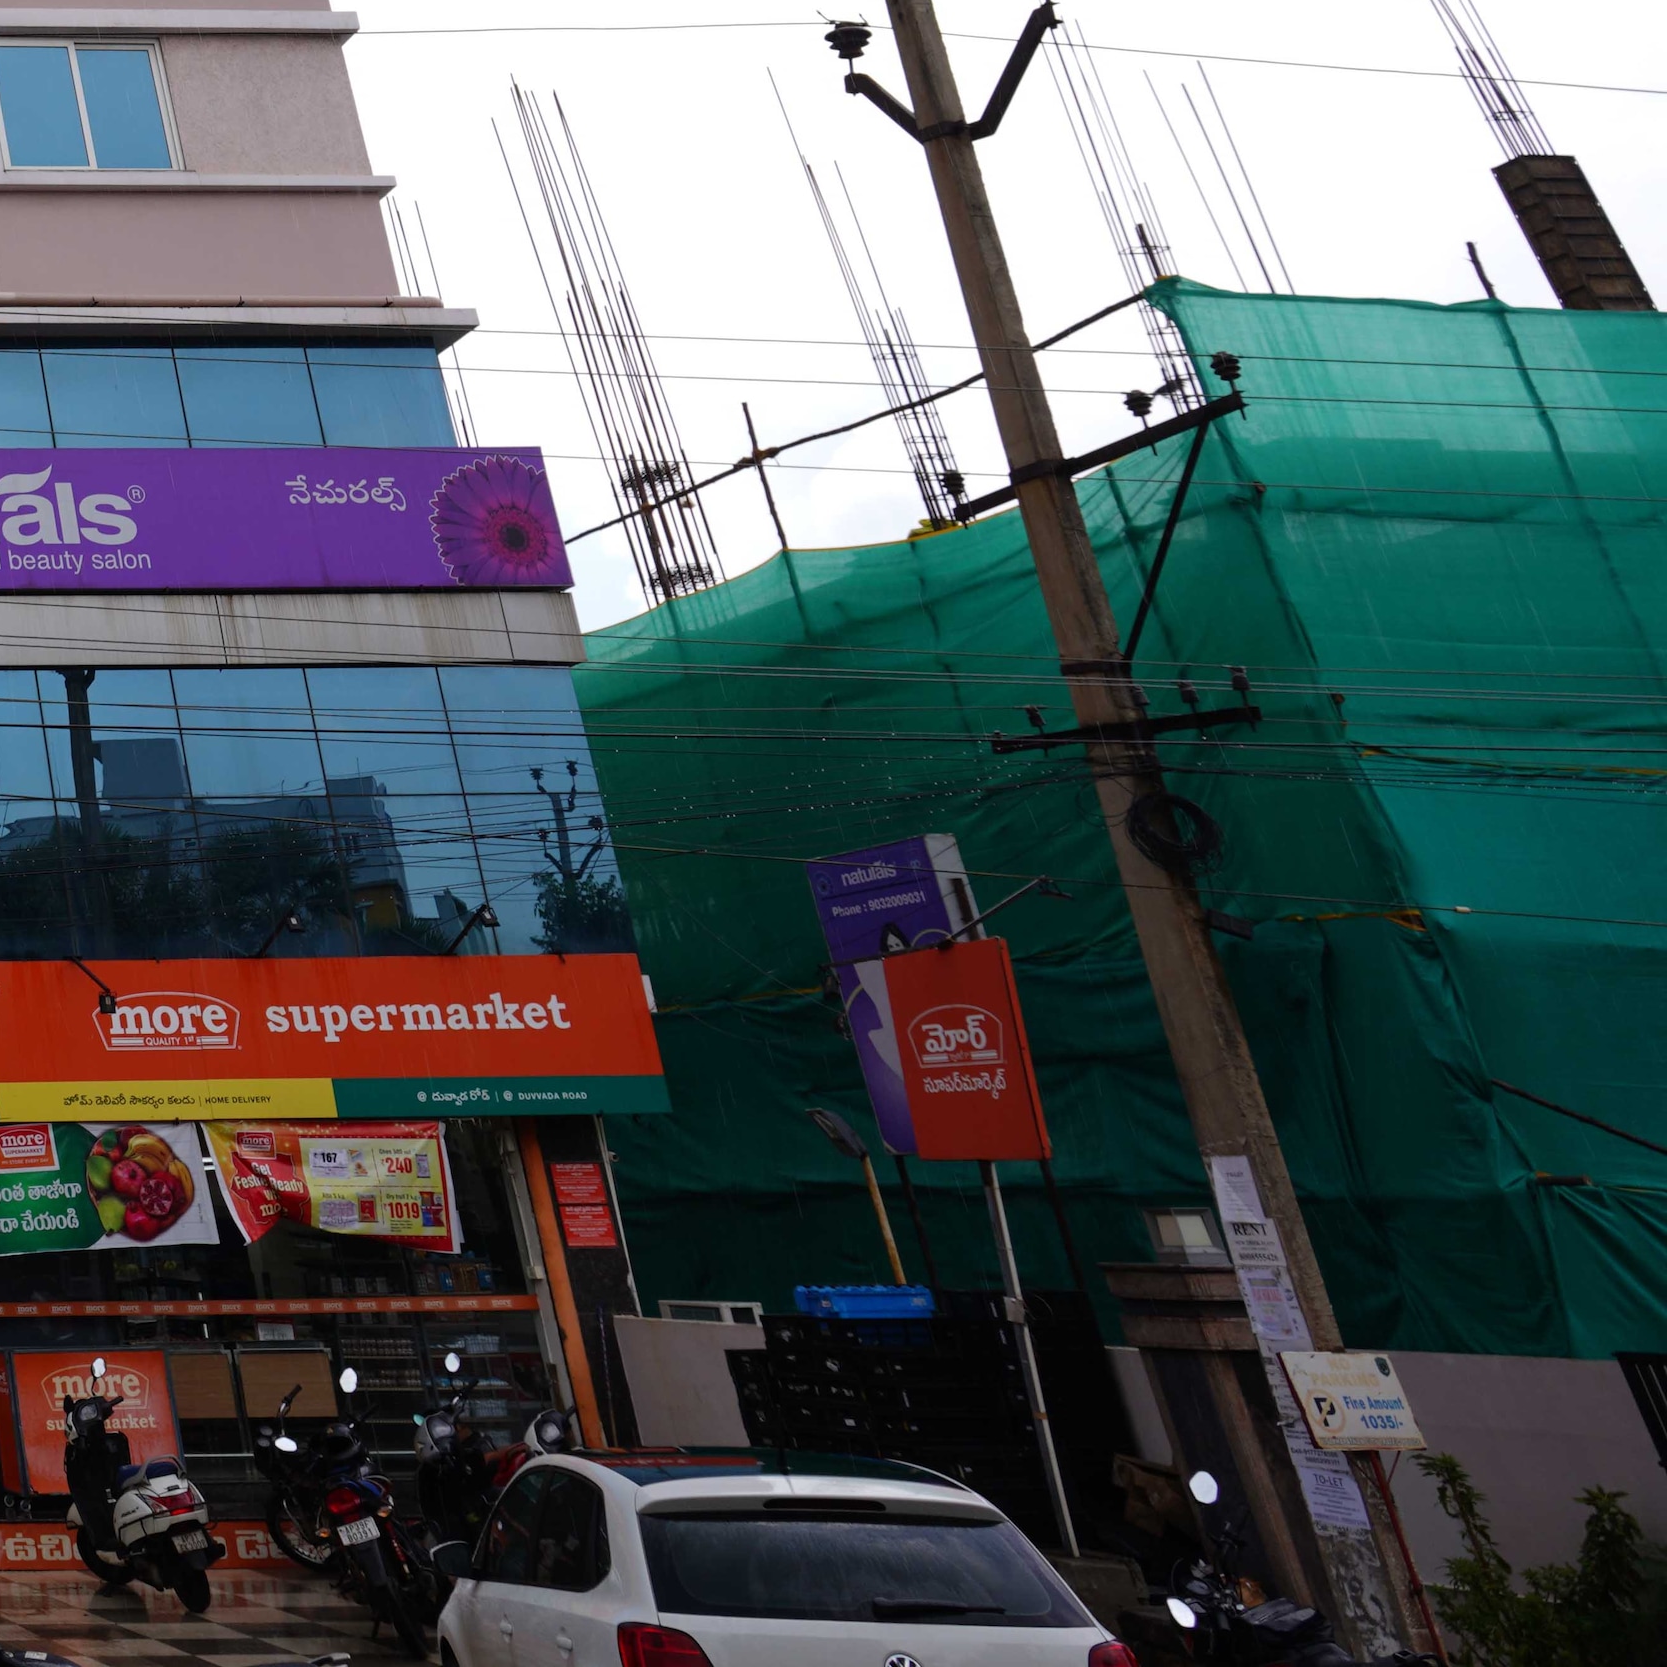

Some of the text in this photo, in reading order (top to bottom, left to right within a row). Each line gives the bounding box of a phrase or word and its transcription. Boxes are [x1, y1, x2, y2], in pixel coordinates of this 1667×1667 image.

[8, 549, 84, 575] beauty
[91, 549, 152, 570] salon
[832, 904, 862, 918] Phone
[110, 1000, 228, 1035] more
[266, 993, 570, 1042] supermarket
[146, 1036, 181, 1046] QUALITY
[205, 1095, 271, 1104] HOME DELIVERY
[518, 1092, 560, 1101] DUVVADA
[562, 1092, 588, 1100] ROAD
[1, 1132, 44, 1148] more
[242, 1135, 272, 1146] more
[4, 1147, 44, 1156] SUPERMARKET
[52, 1373, 141, 1398] more
[1343, 1396, 1405, 1410] Fine Amount
[1361, 1416, 1403, 1429] 1035/-
[1313, 1474, 1343, 1487] TO-LET
